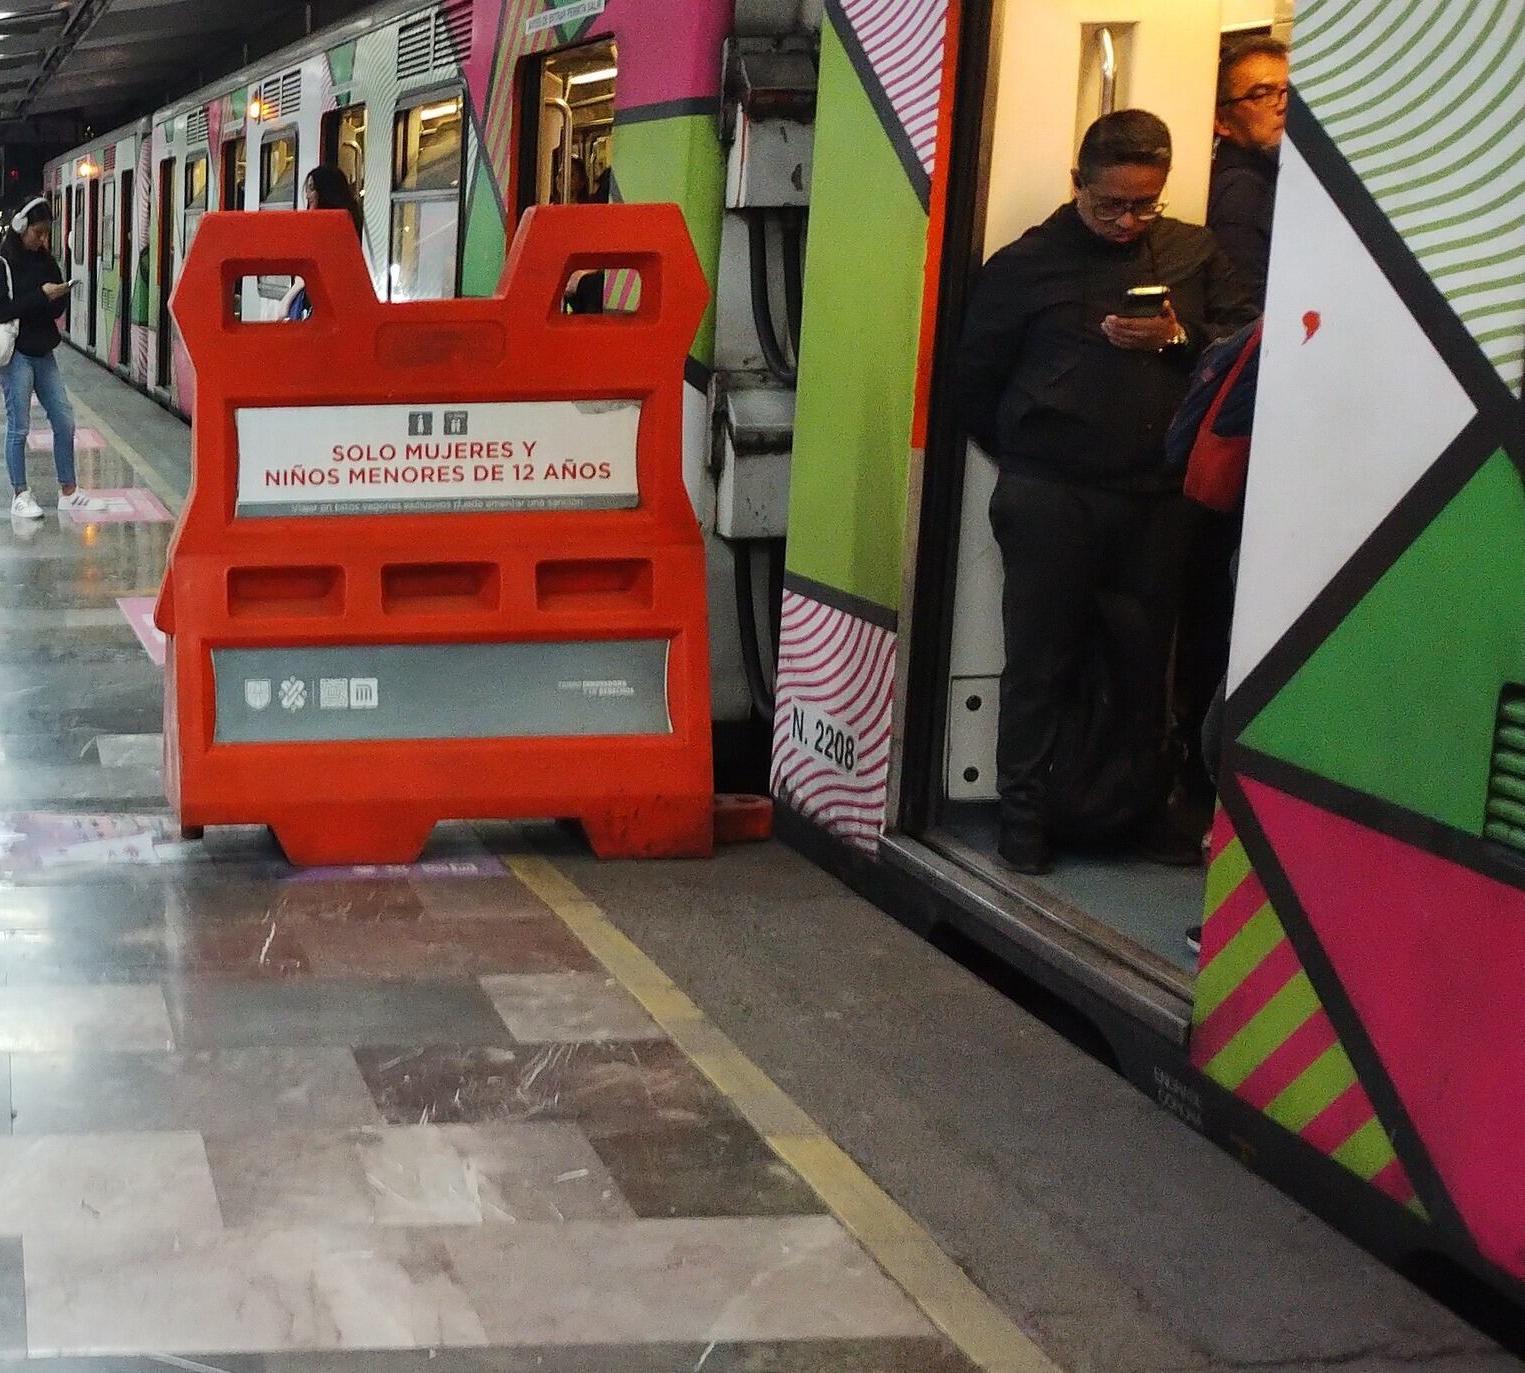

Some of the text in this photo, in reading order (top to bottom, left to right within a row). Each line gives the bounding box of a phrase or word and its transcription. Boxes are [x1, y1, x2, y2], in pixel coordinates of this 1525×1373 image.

[332, 440, 538, 462] SOLO MUJERES Y
[265, 458, 612, 486] NIÑOS MENORES DE 12 AÑOS
[792, 705, 855, 771] N. 2208
